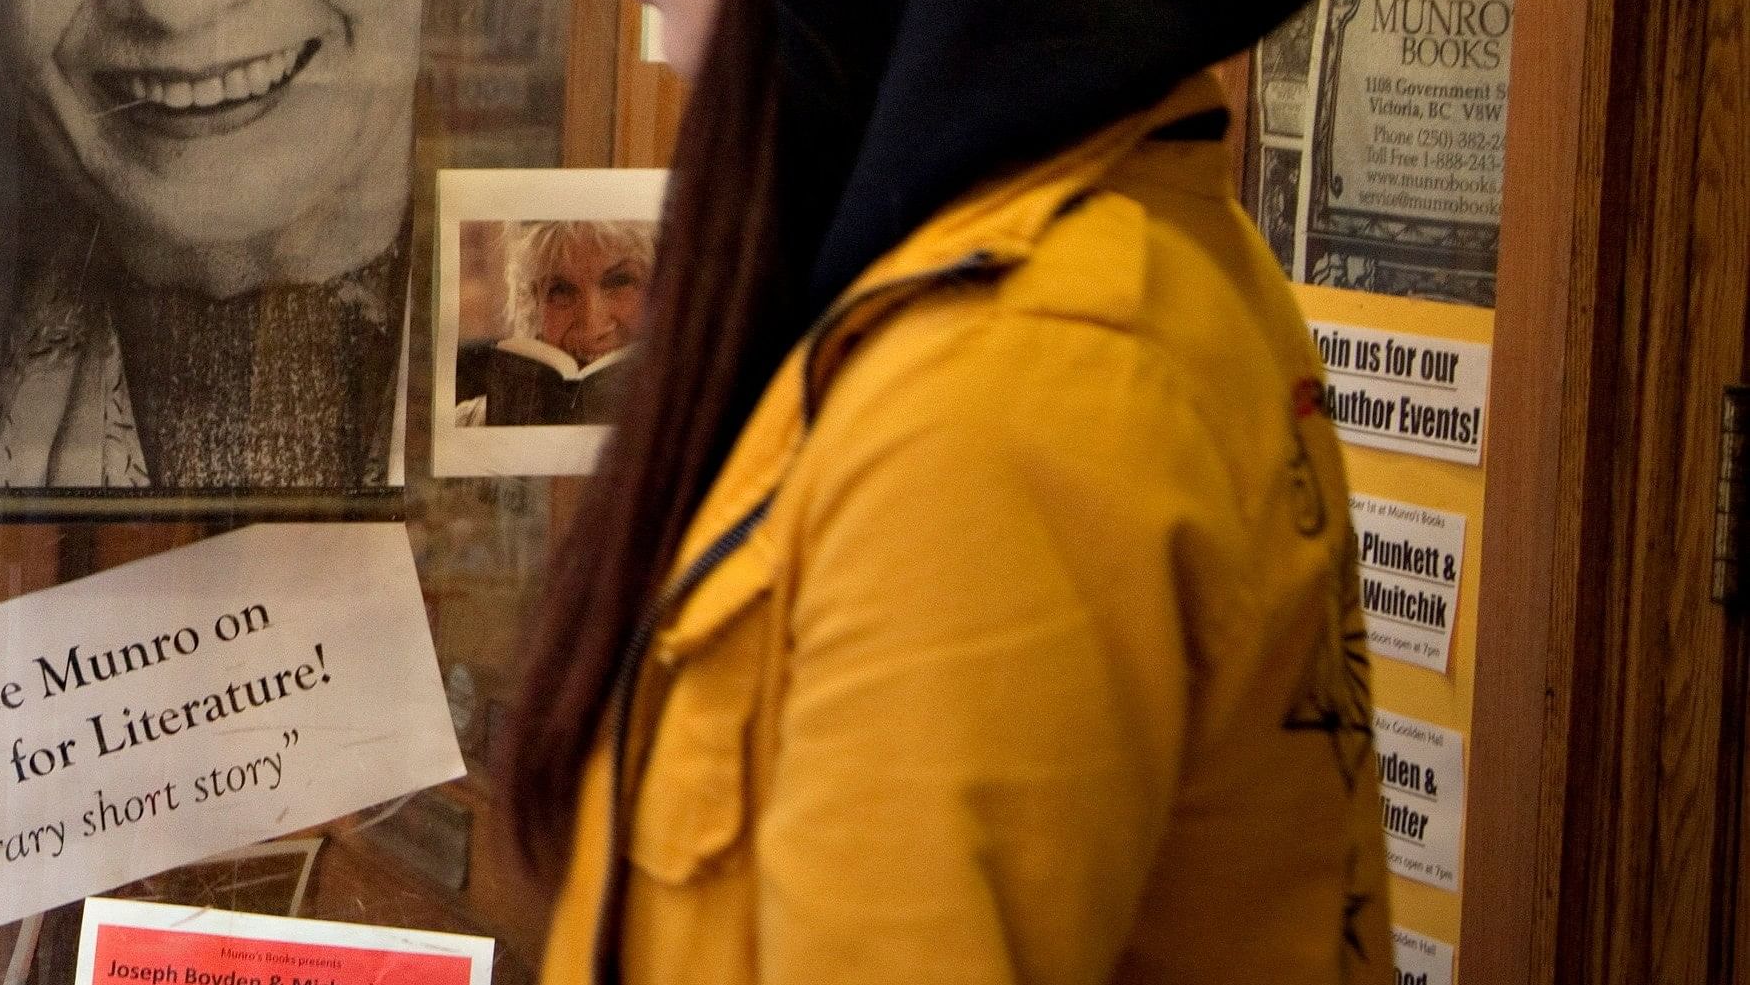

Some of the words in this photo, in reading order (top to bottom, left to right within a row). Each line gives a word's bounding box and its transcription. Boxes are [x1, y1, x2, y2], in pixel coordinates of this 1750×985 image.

[1401, 37, 1500, 70] BOOKS
[1369, 96, 1424, 119] Victoria,
[1429, 102, 1452, 119] BC
[1396, 78, 1490, 100] Government
[1496, 82, 1507, 100] S
[1374, 124, 1413, 145] Phone
[1367, 170, 1502, 194] www.munrobooks.
[1355, 340, 1381, 373] us
[1385, 338, 1417, 378] for
[1421, 348, 1459, 384] our
[1326, 384, 1395, 432] Author
[1399, 396, 1481, 445] Events!
[1362, 530, 1440, 580] Plunkett
[1442, 552, 1458, 582] &
[1363, 577, 1448, 628] Wuitchik
[33, 627, 199, 700] Munro
[214, 601, 272, 645] on
[11, 738, 76, 783] for
[88, 644, 332, 759] Literature!
[82, 780, 180, 838] short
[194, 727, 300, 803] story”
[1376, 751, 1420, 791] yden
[1425, 767, 1438, 796] &
[1381, 795, 1428, 840] inter
[108, 959, 178, 984] Joseph
